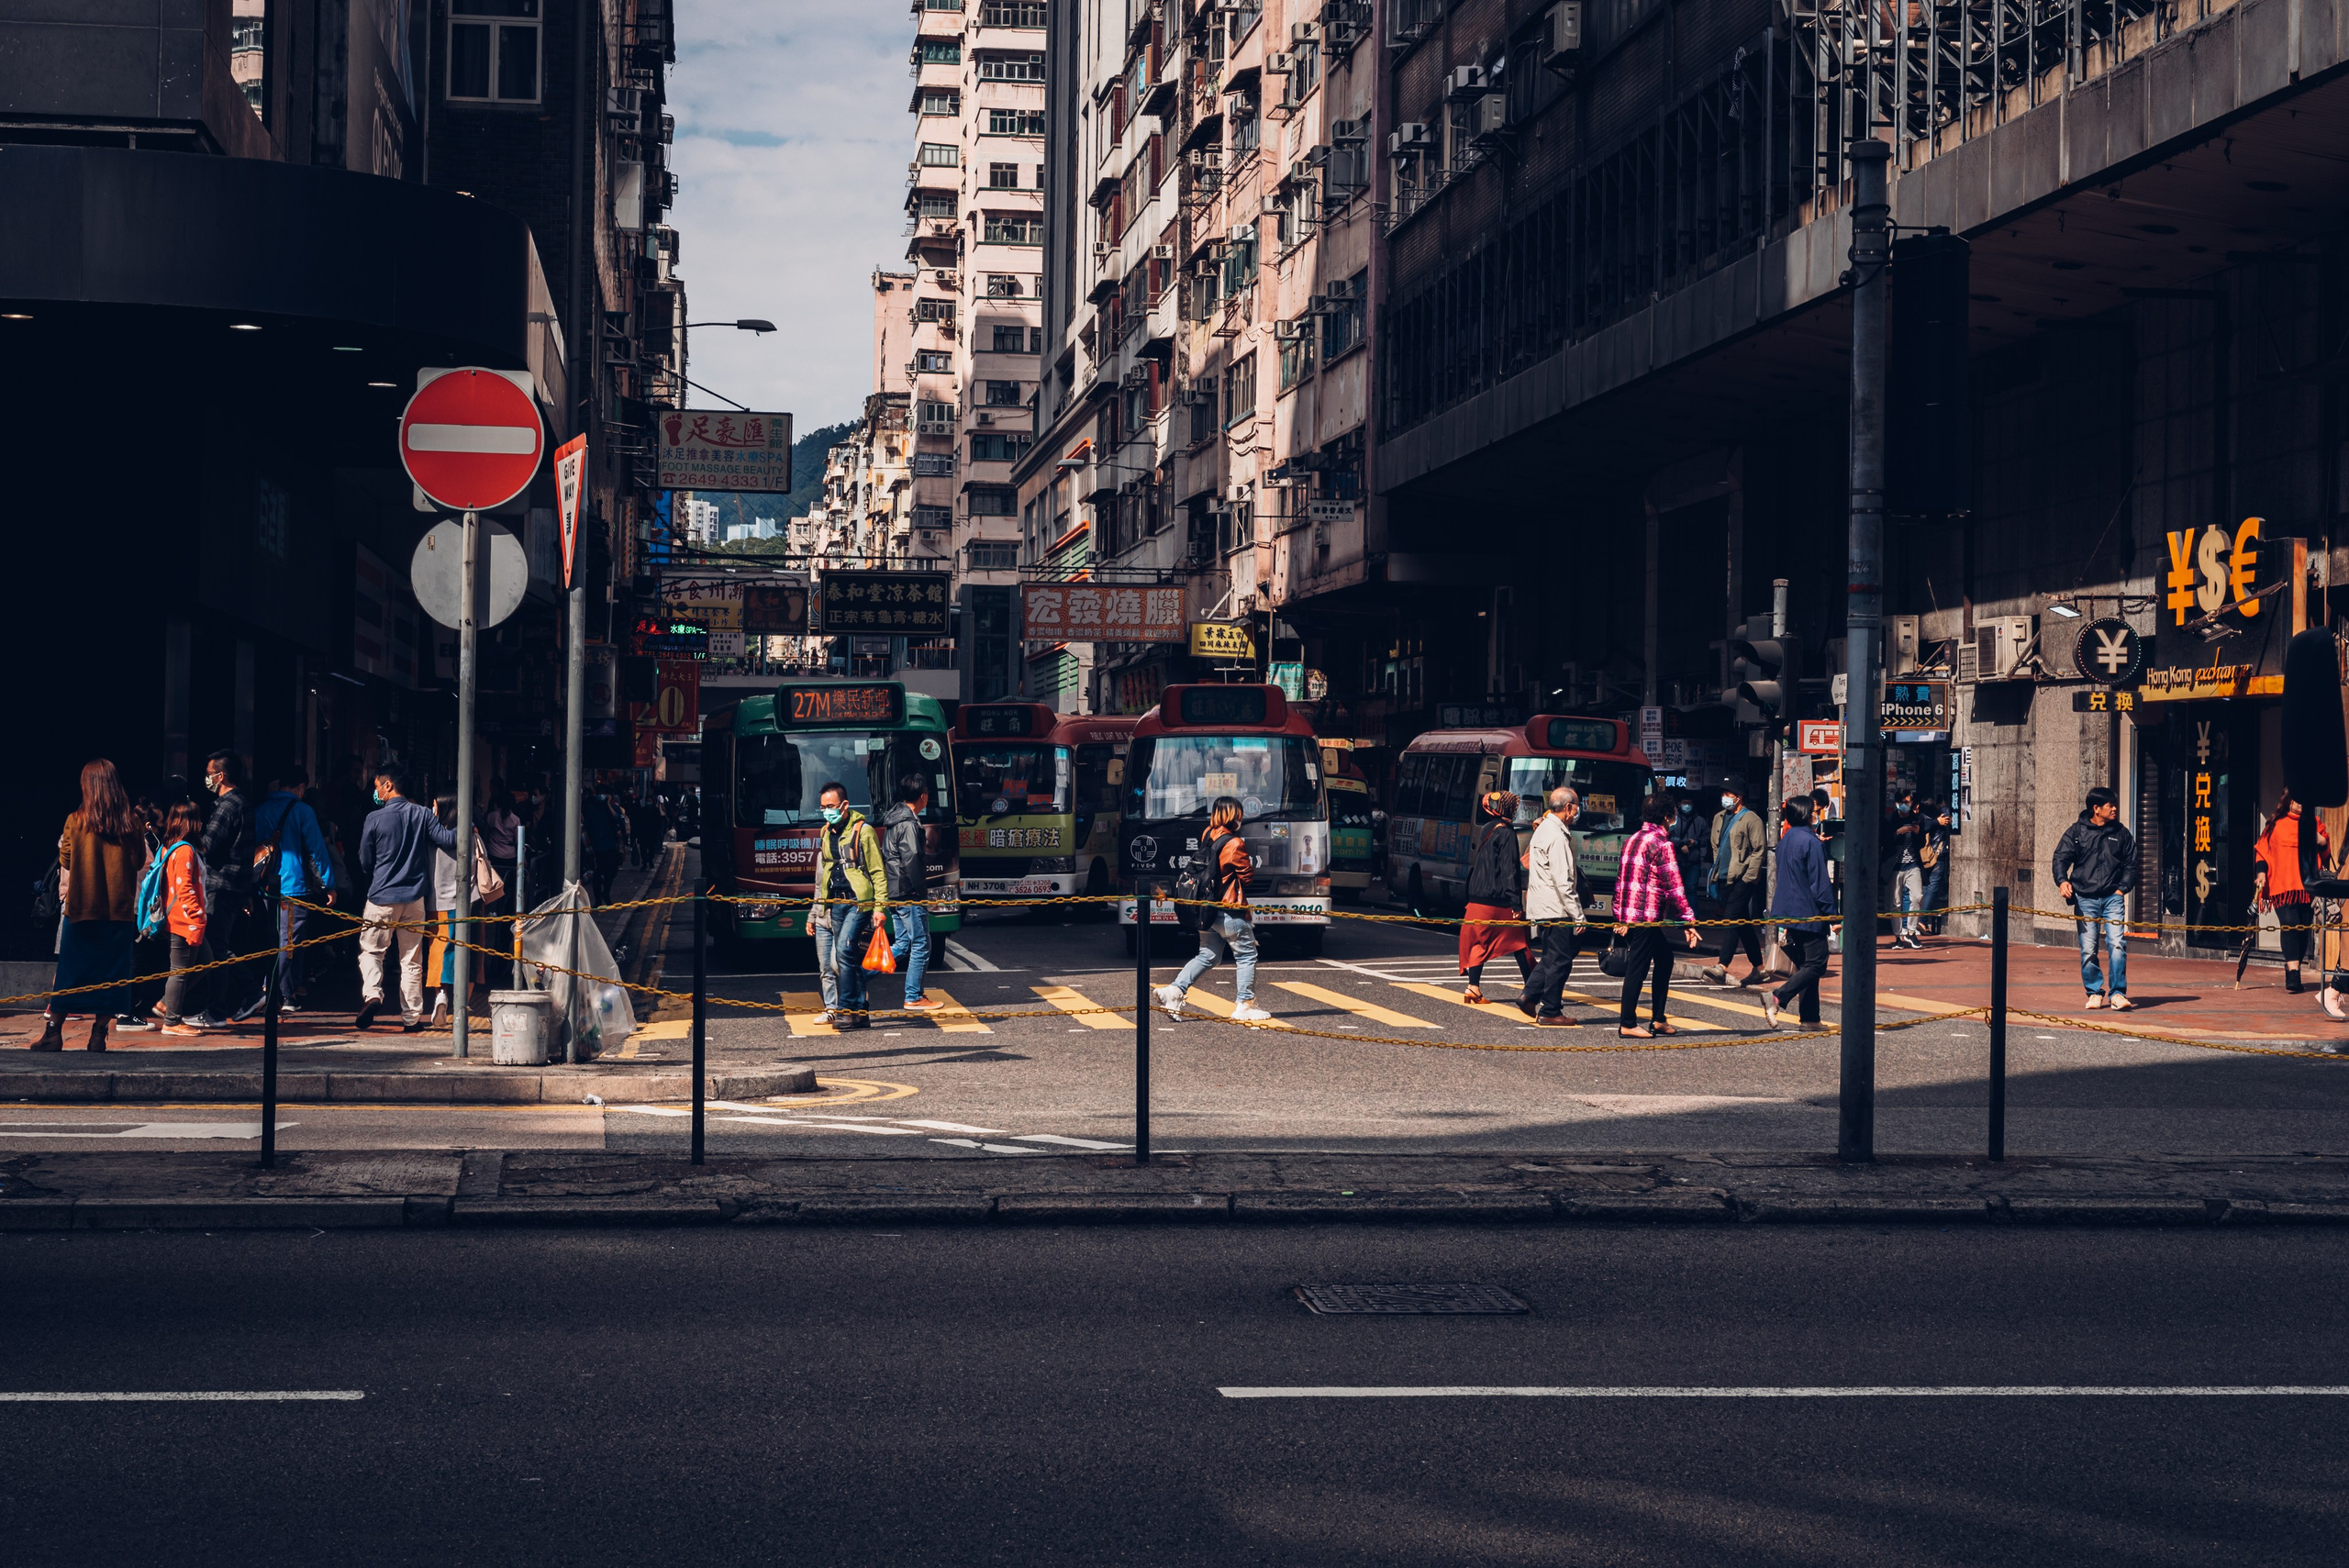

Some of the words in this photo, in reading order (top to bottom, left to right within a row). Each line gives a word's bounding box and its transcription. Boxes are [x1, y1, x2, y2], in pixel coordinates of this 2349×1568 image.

[685, 415, 766, 448] 足豪匯
[769, 417, 784, 449] 養生館
[563, 458, 575, 480] GIVE
[661, 462, 690, 472] FOOT
[691, 463, 740, 473] MASSAGE
[743, 465, 784, 475] BEAUTY
[679, 473, 717, 486] 2649
[720, 475, 759, 488] 4333
[763, 477, 784, 488] 1/F
[564, 481, 575, 502] WAY
[1027, 588, 1182, 626] 宏發燒臘
[2146, 667, 2169, 688] Hong
[2169, 666, 2193, 688] Kong
[2195, 646, 2252, 686] exchange
[831, 688, 890, 711] 樂民新邨
[1894, 685, 1931, 702] 熱賣
[794, 692, 830, 718] 27M
[1881, 703, 1932, 716] iPhone
[1934, 704, 1943, 716] 6
[980, 717, 1020, 732] 旺角
[1443, 706, 1520, 726] 電訊世界
[1584, 725, 1596, 733] KOK
[1665, 741, 1682, 752] PHONE
[1665, 754, 1682, 765] REPAIR
[1246, 804, 1257, 812] 114
[959, 829, 987, 845] 終極
[989, 828, 1061, 848] 暗瘡療法
[983, 882, 1006, 890] 3708
